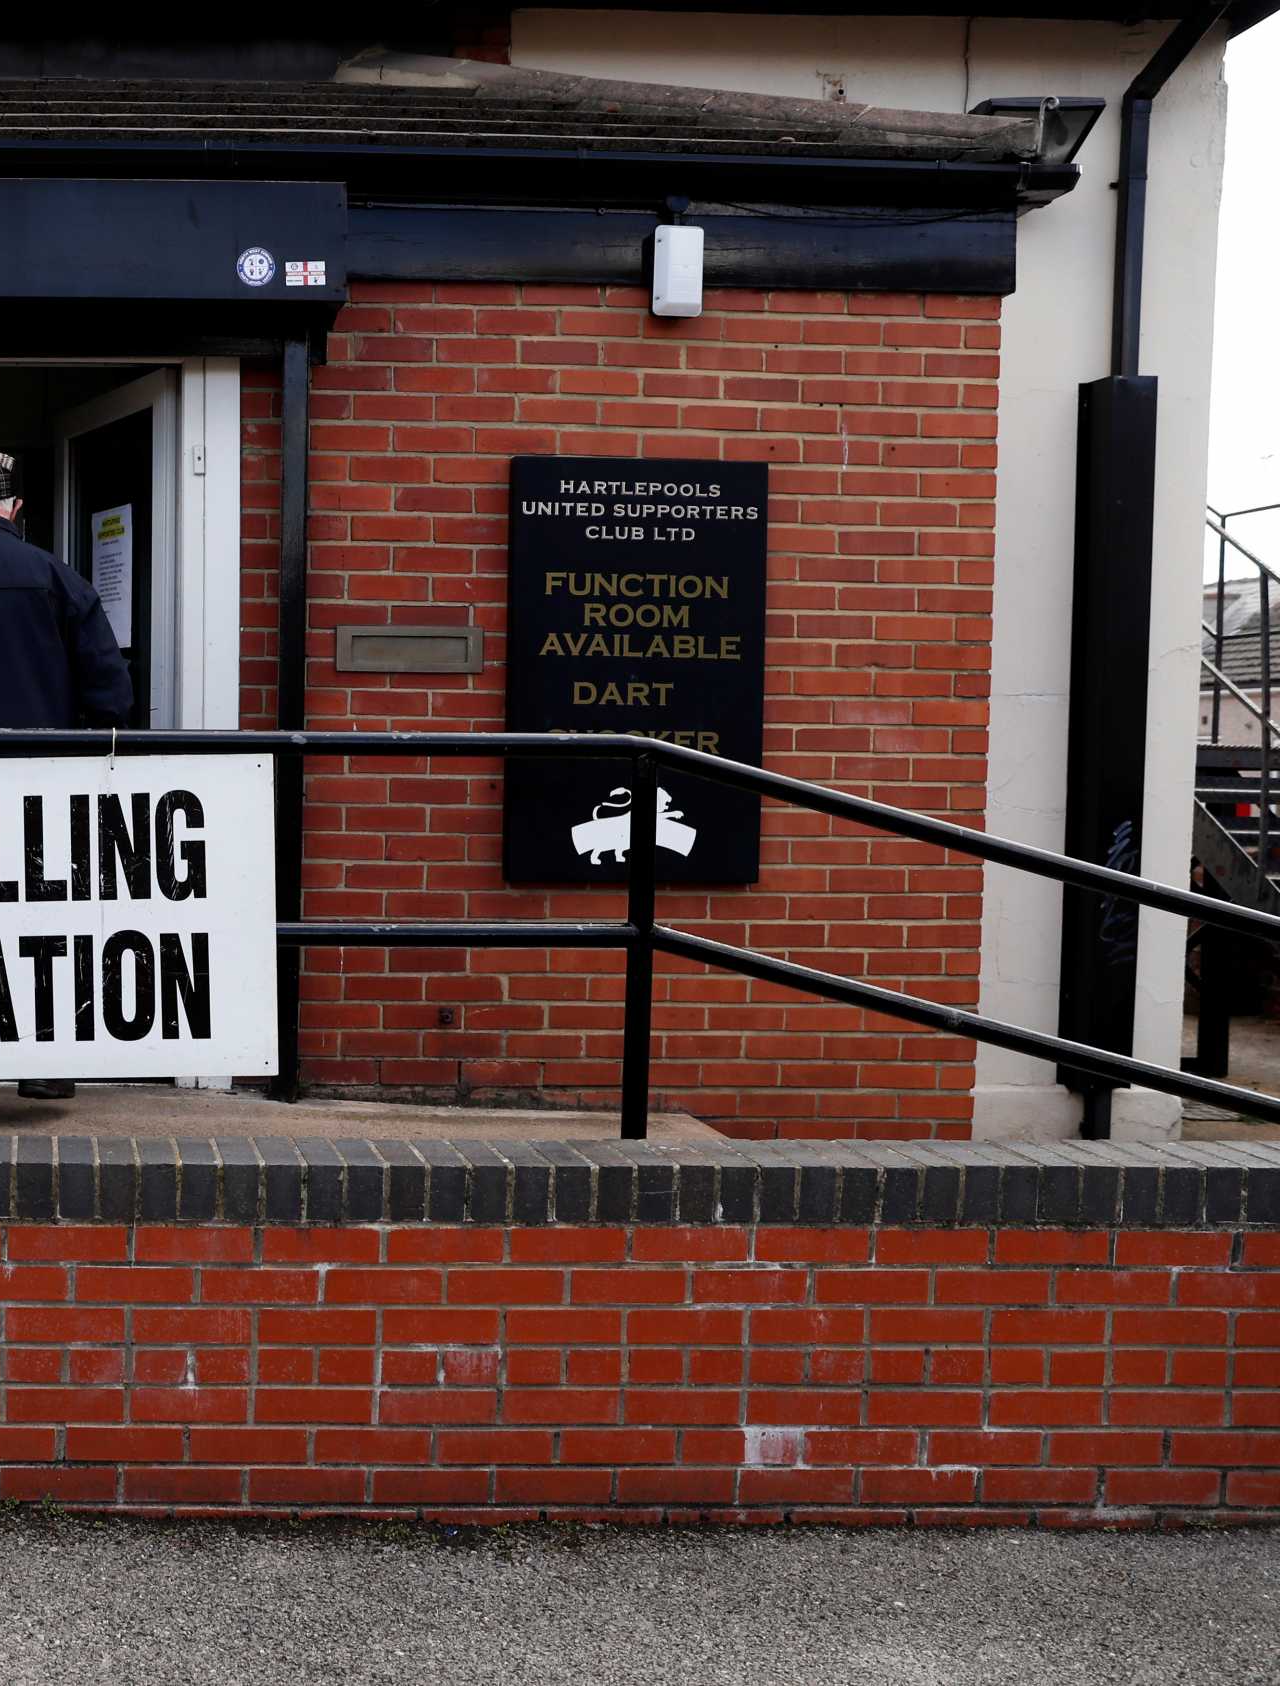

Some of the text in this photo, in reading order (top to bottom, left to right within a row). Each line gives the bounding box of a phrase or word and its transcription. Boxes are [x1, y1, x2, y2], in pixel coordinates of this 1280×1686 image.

[559, 480, 721, 498] HARTLEPOOLS
[521, 501, 759, 520] UNITED SUPPORTERS
[585, 525, 696, 542] CLUB LTD
[544, 571, 729, 599] FUNCTION
[583, 603, 690, 628] ROOM
[538, 632, 742, 660] AVAILABLE
[572, 681, 674, 706] DART
